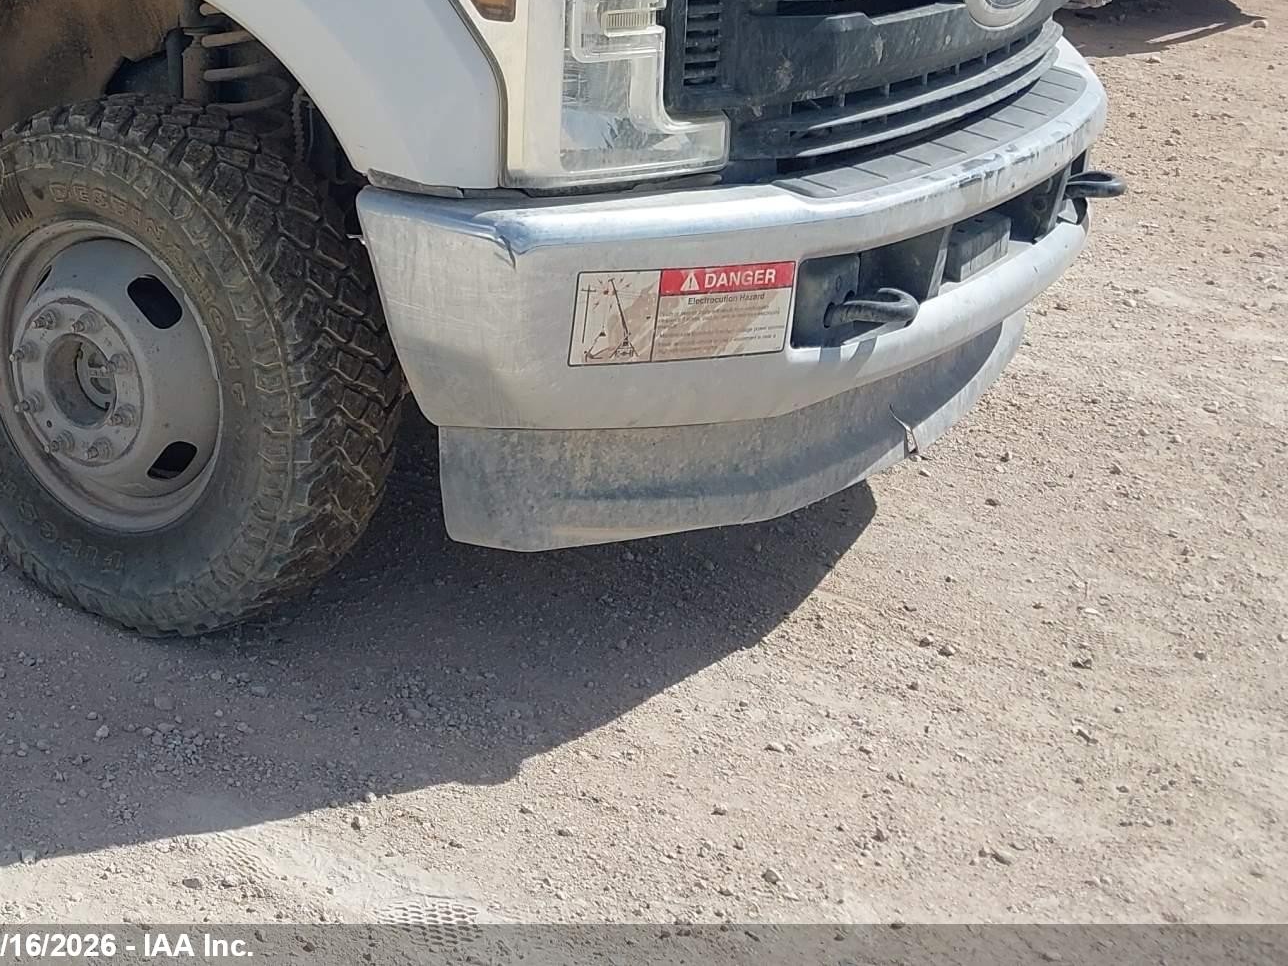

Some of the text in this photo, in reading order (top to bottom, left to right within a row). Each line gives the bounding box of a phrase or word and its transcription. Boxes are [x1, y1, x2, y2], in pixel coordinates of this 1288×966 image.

[703, 268, 777, 289] DANGER
[687, 292, 766, 305] Electrocution Hazard
